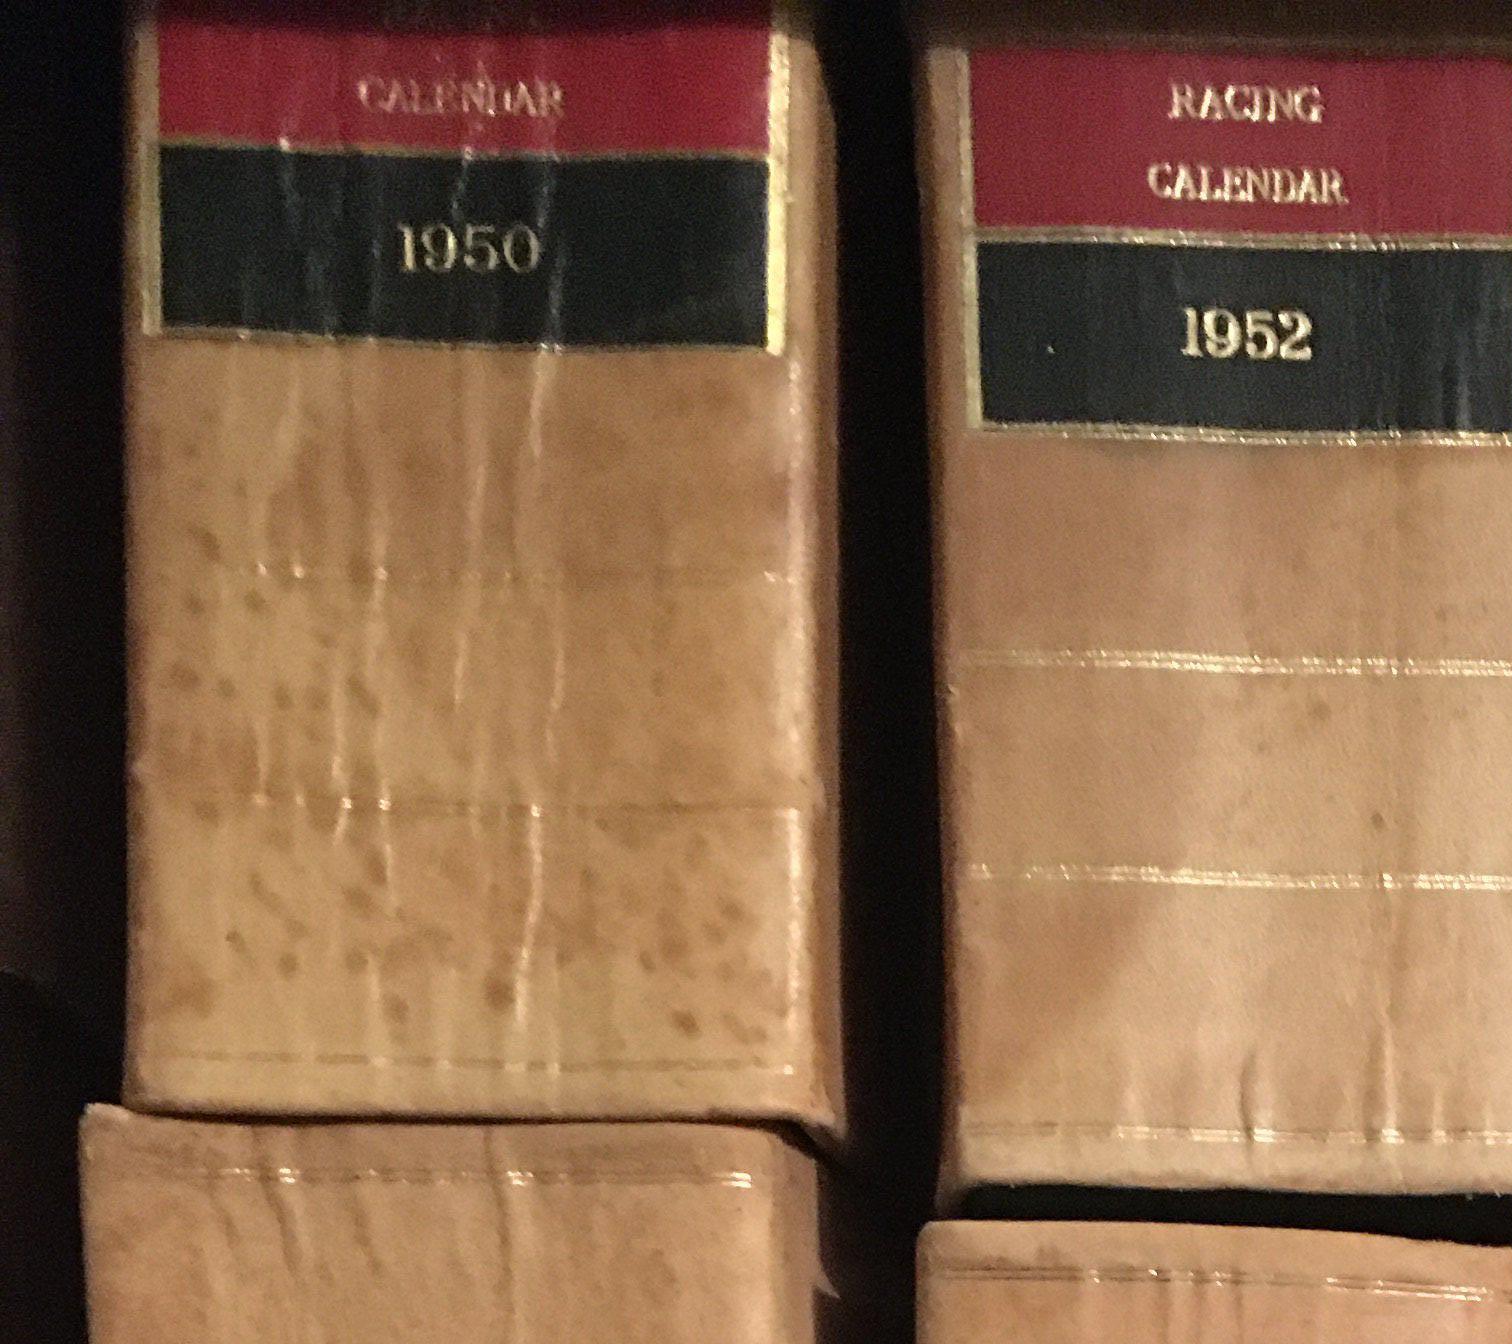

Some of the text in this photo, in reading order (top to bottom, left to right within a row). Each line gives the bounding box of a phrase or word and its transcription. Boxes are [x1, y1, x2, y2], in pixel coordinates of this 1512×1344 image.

[357, 76, 566, 117] CALENDAR
[1168, 82, 1323, 124] RACING
[1146, 164, 1349, 206] CALENDAR
[399, 223, 541, 274] 1950
[1180, 309, 1314, 363] 1952
